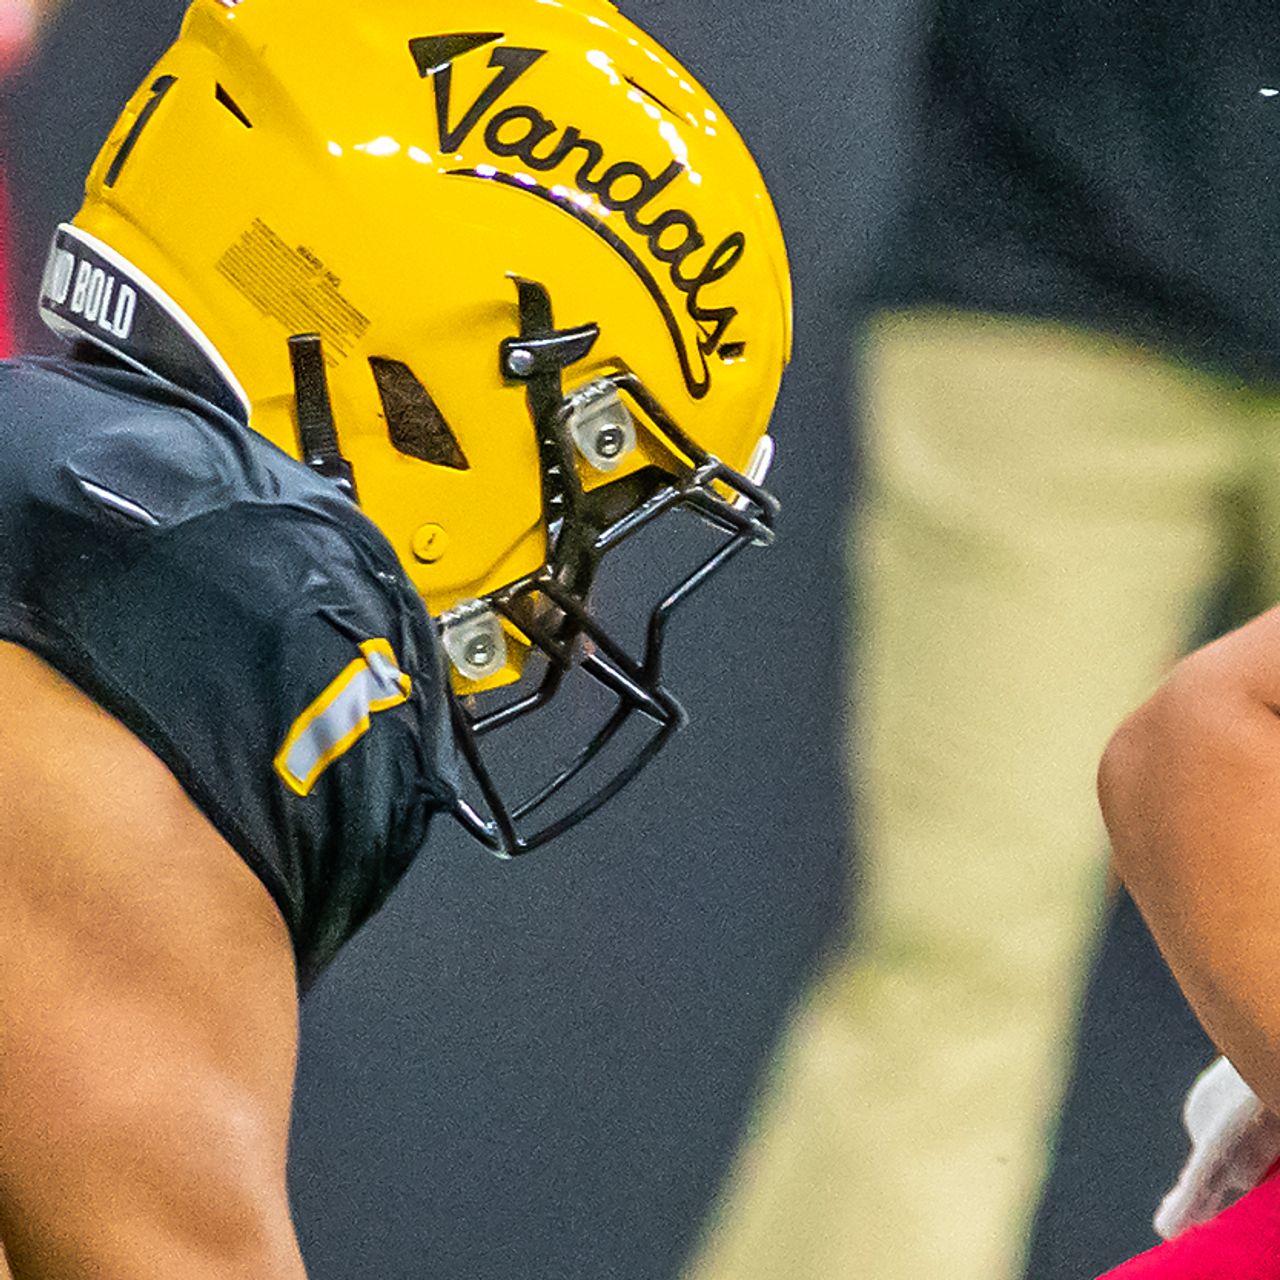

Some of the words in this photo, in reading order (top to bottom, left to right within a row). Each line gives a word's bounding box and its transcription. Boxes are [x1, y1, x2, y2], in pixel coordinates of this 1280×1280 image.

[103, 74, 179, 189] 1
[407, 31, 744, 398] Vandals
[70, 258, 137, 340] BOLD
